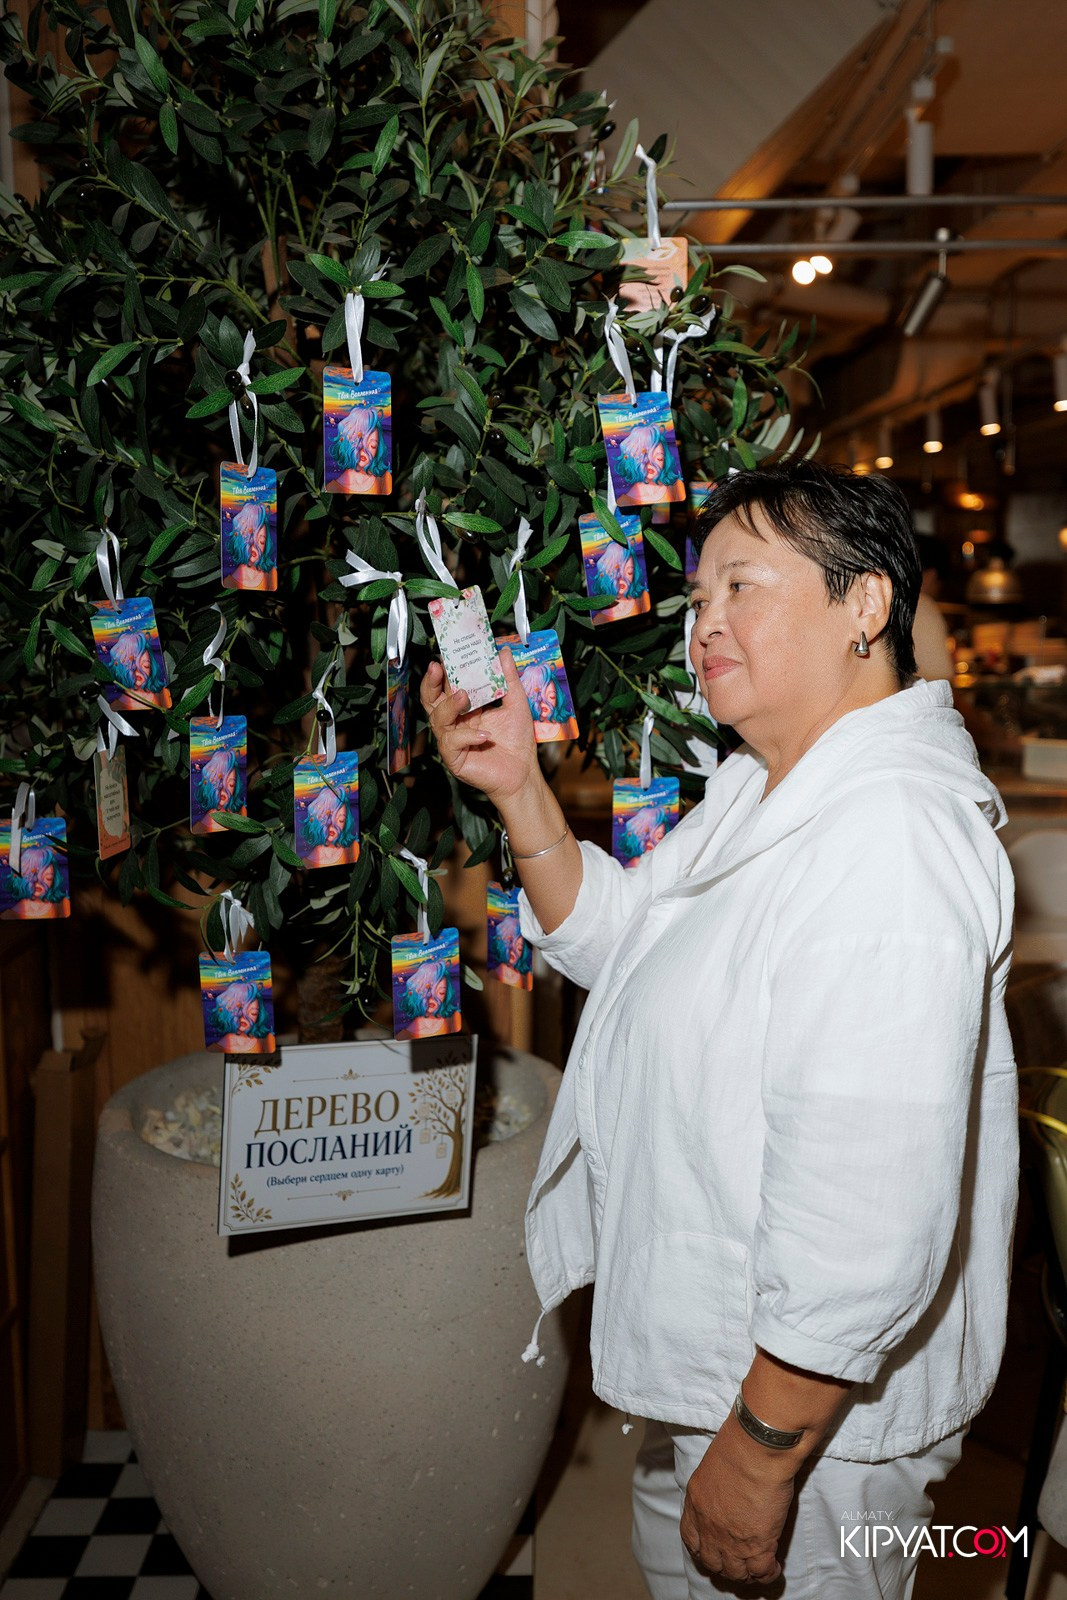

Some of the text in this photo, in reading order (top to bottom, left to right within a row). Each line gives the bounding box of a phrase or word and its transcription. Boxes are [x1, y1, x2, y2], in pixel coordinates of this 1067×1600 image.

[254, 1089, 401, 1138] ДЕРЕВО
[244, 1124, 414, 1169] ПОСЛАНИЙ
[266, 1164, 405, 1188] (Выбери сердцем одну карту)
